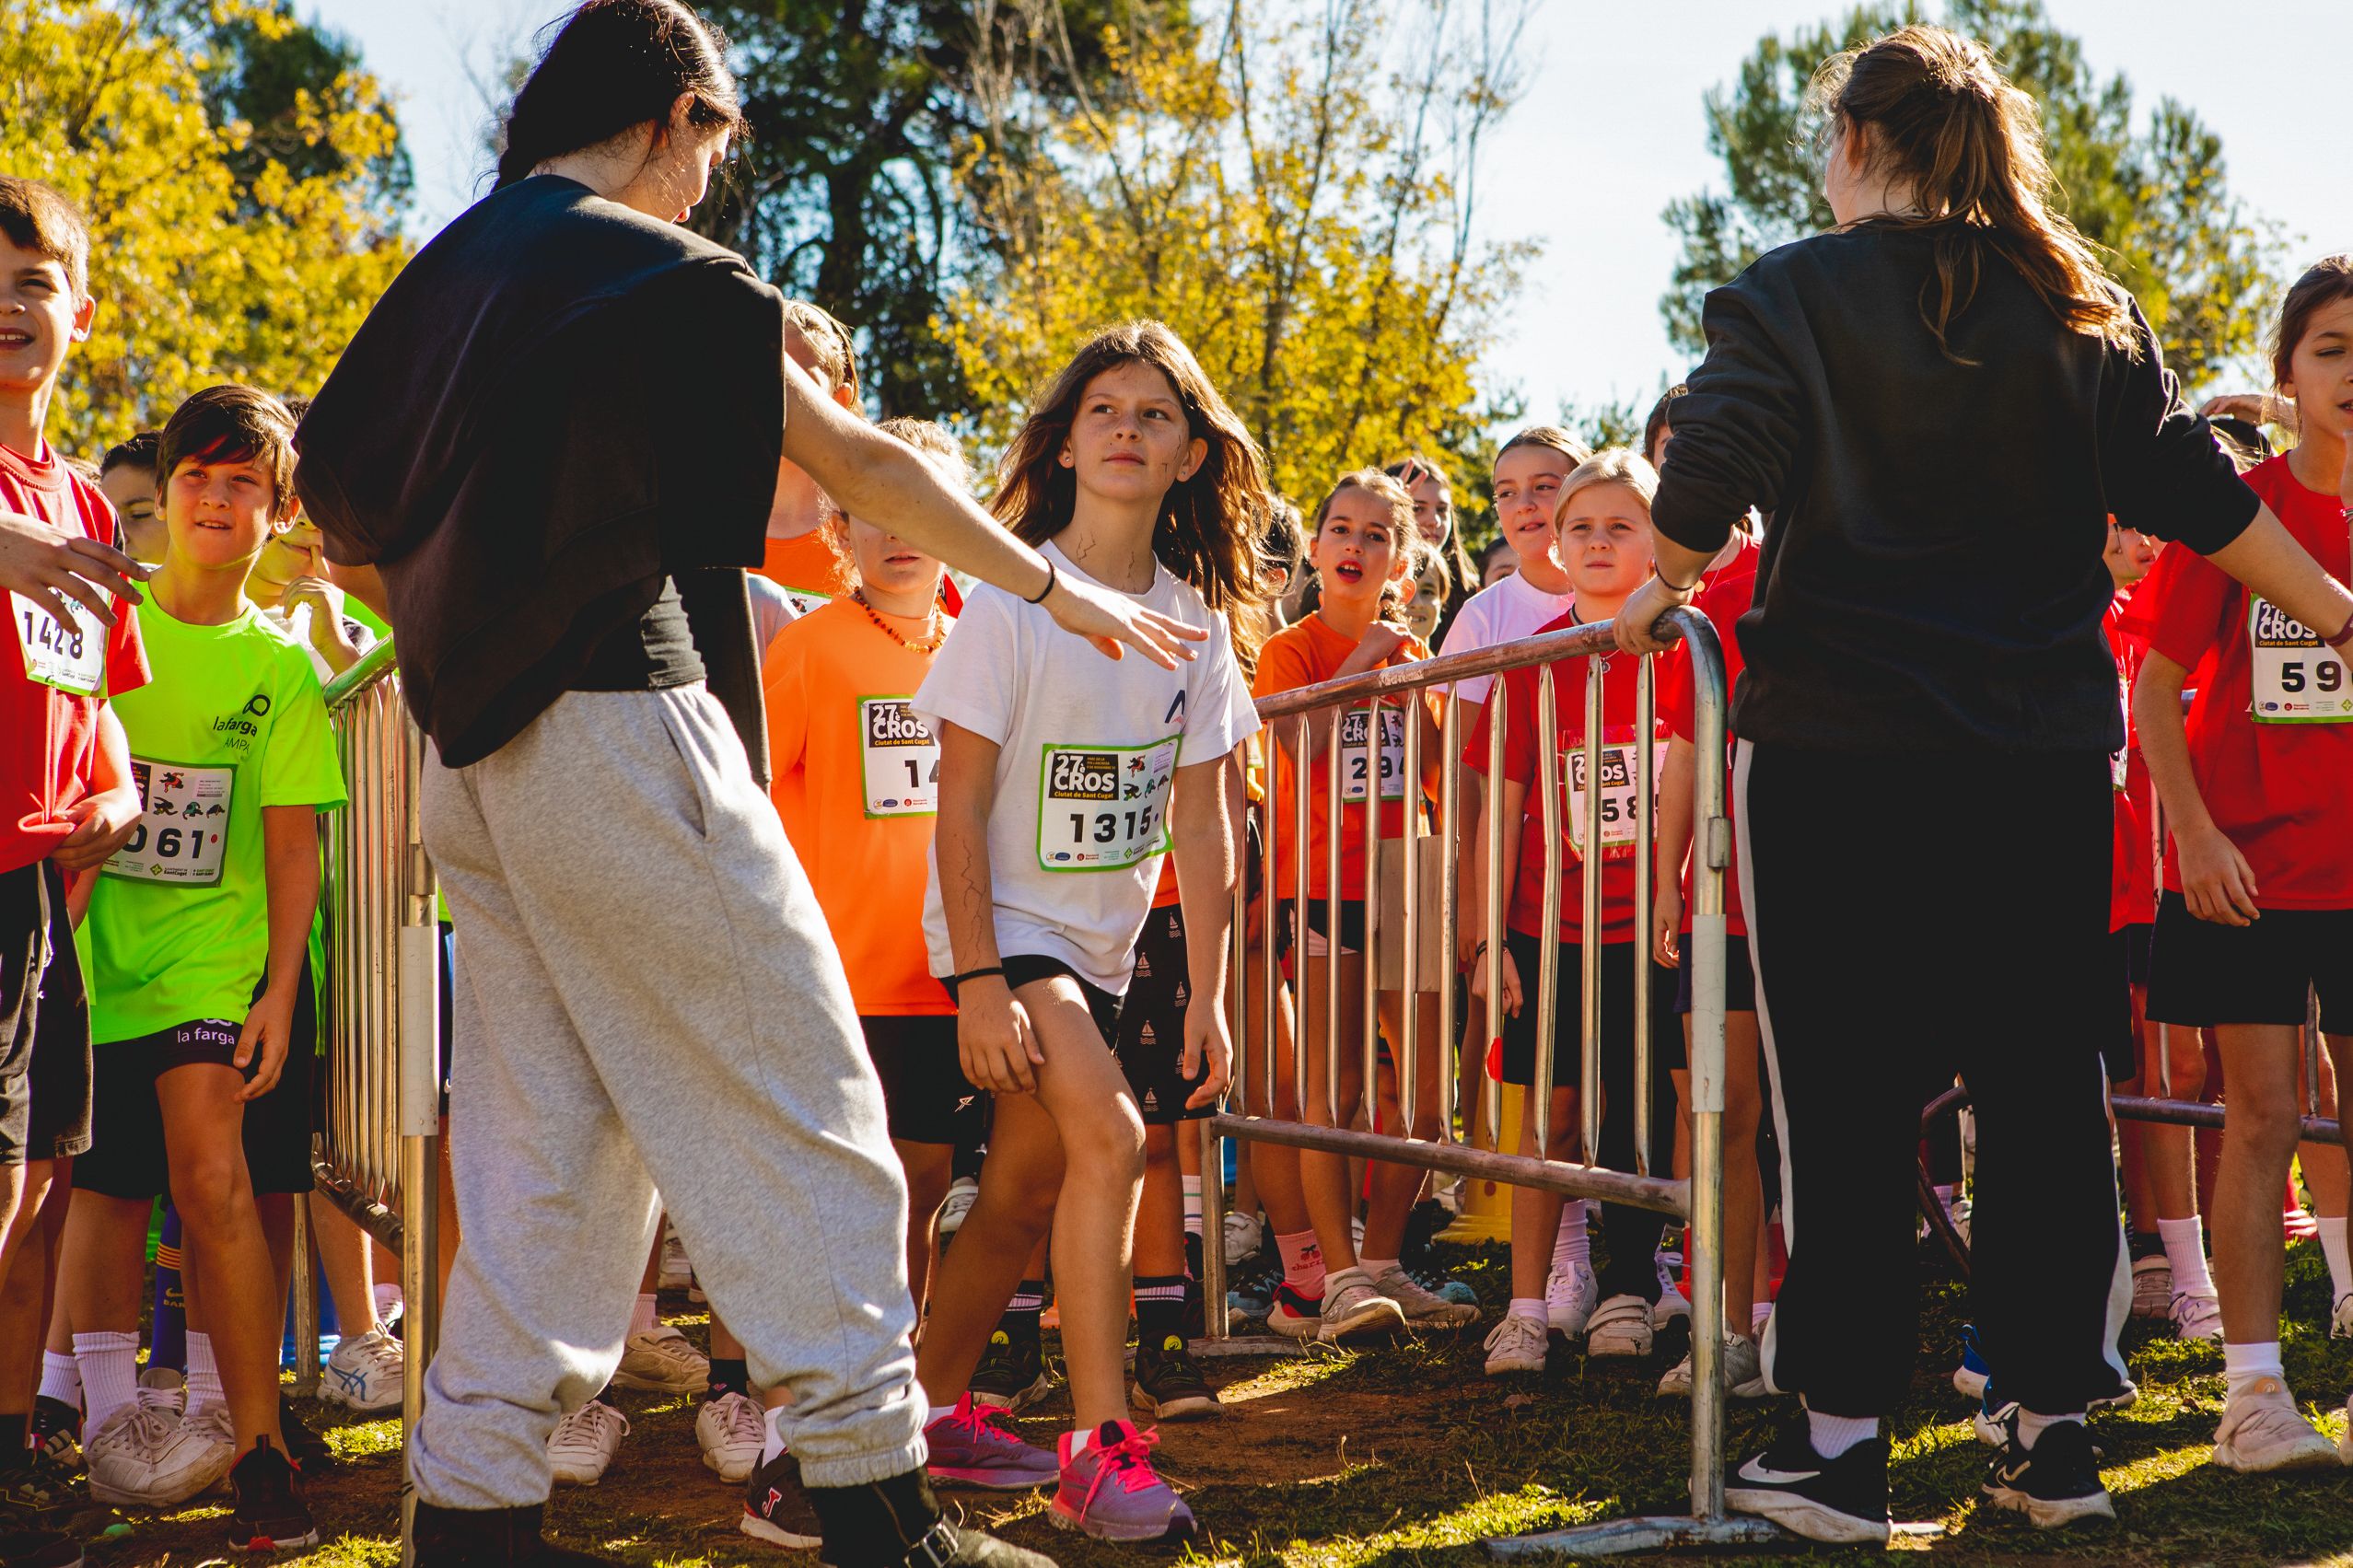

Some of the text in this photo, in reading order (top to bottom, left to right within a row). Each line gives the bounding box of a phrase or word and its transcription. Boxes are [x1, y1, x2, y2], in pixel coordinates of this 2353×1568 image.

[24, 611, 83, 660] 1428
[2282, 661, 2353, 692] 59
[213, 716, 258, 738] lafarga
[873, 720, 929, 739] CROS
[1342, 727, 1386, 742] CRS
[224, 738, 250, 754] AMPA
[1352, 756, 1404, 779] 29
[1576, 764, 1624, 785] COS
[1054, 771, 1115, 792] CROS
[1070, 804, 1153, 843] 1315
[178, 1028, 235, 1045] la farga
